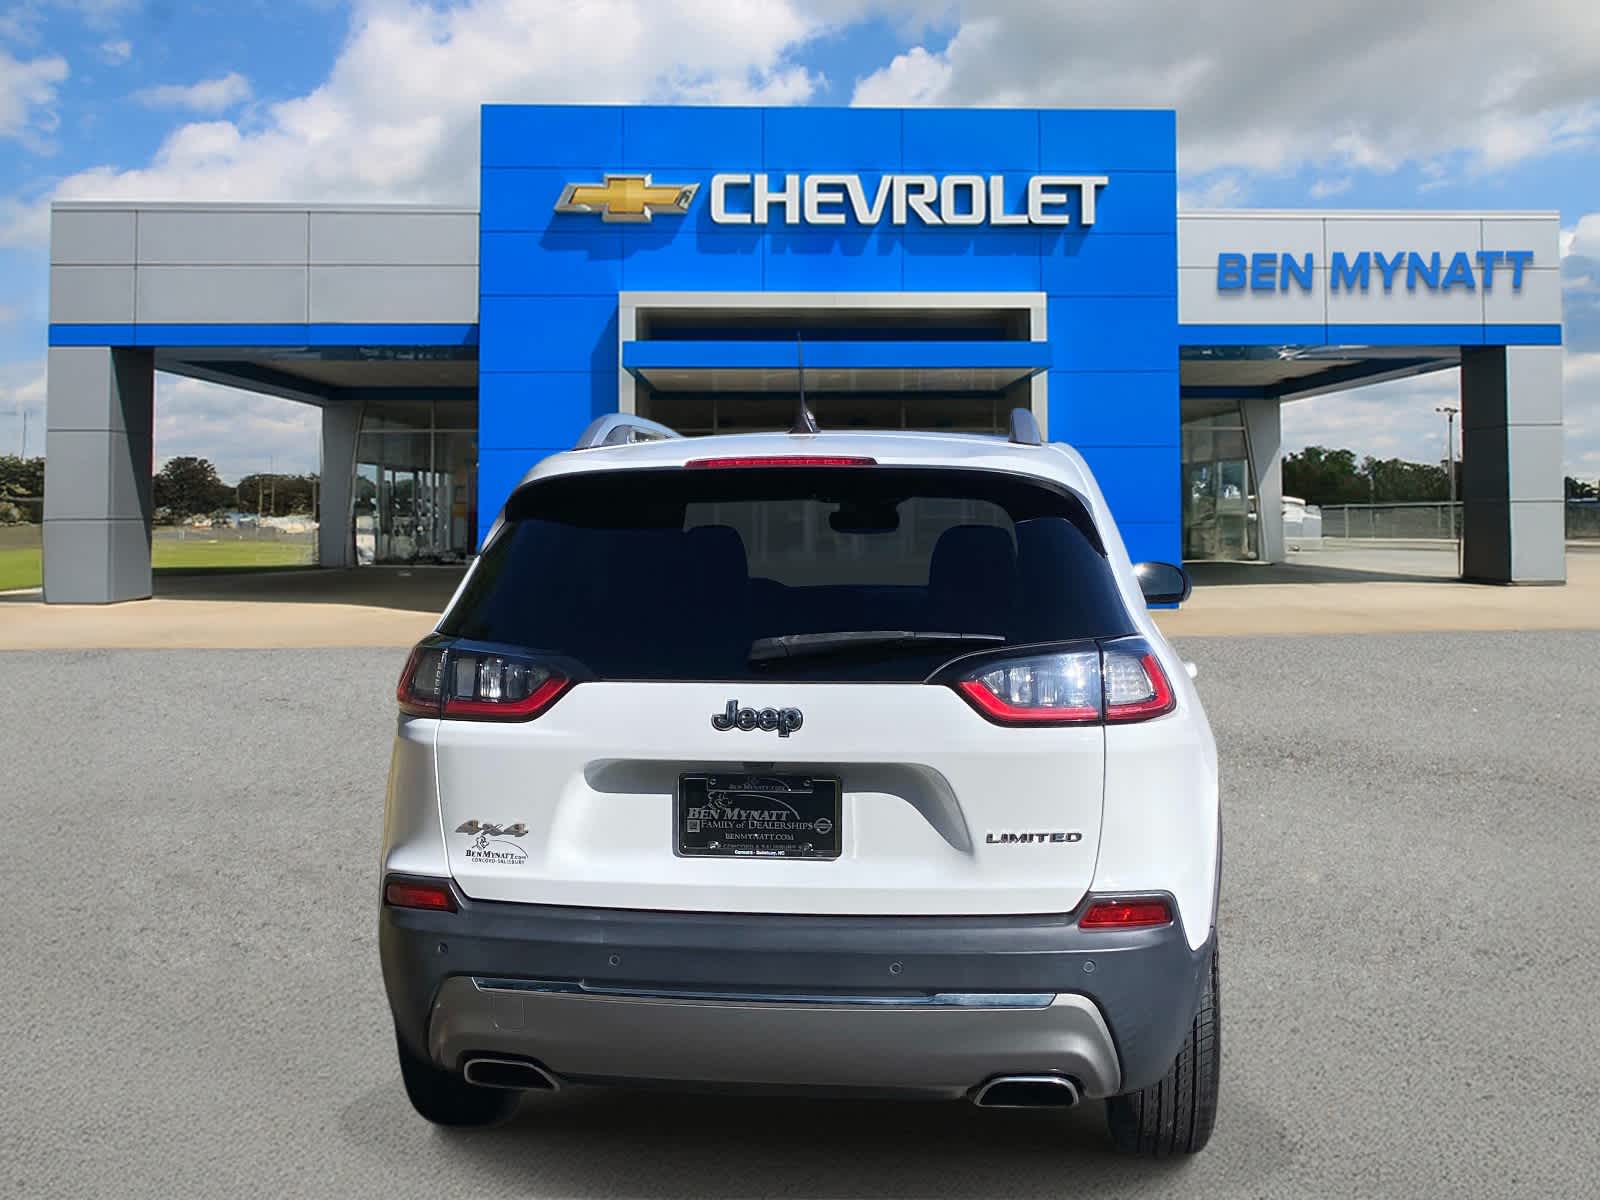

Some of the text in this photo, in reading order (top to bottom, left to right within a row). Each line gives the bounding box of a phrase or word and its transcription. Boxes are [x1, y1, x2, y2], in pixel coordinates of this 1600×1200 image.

[711, 173, 1109, 225] CHEVROLET
[1217, 250, 1534, 290] BEN MYNATT
[711, 699, 803, 738] Jeep
[687, 808, 790, 821] BEN MYNATT
[701, 820, 736, 829] FAMILY
[748, 820, 813, 830] DEALERSHIPS
[986, 833, 1083, 844] LIMITED
